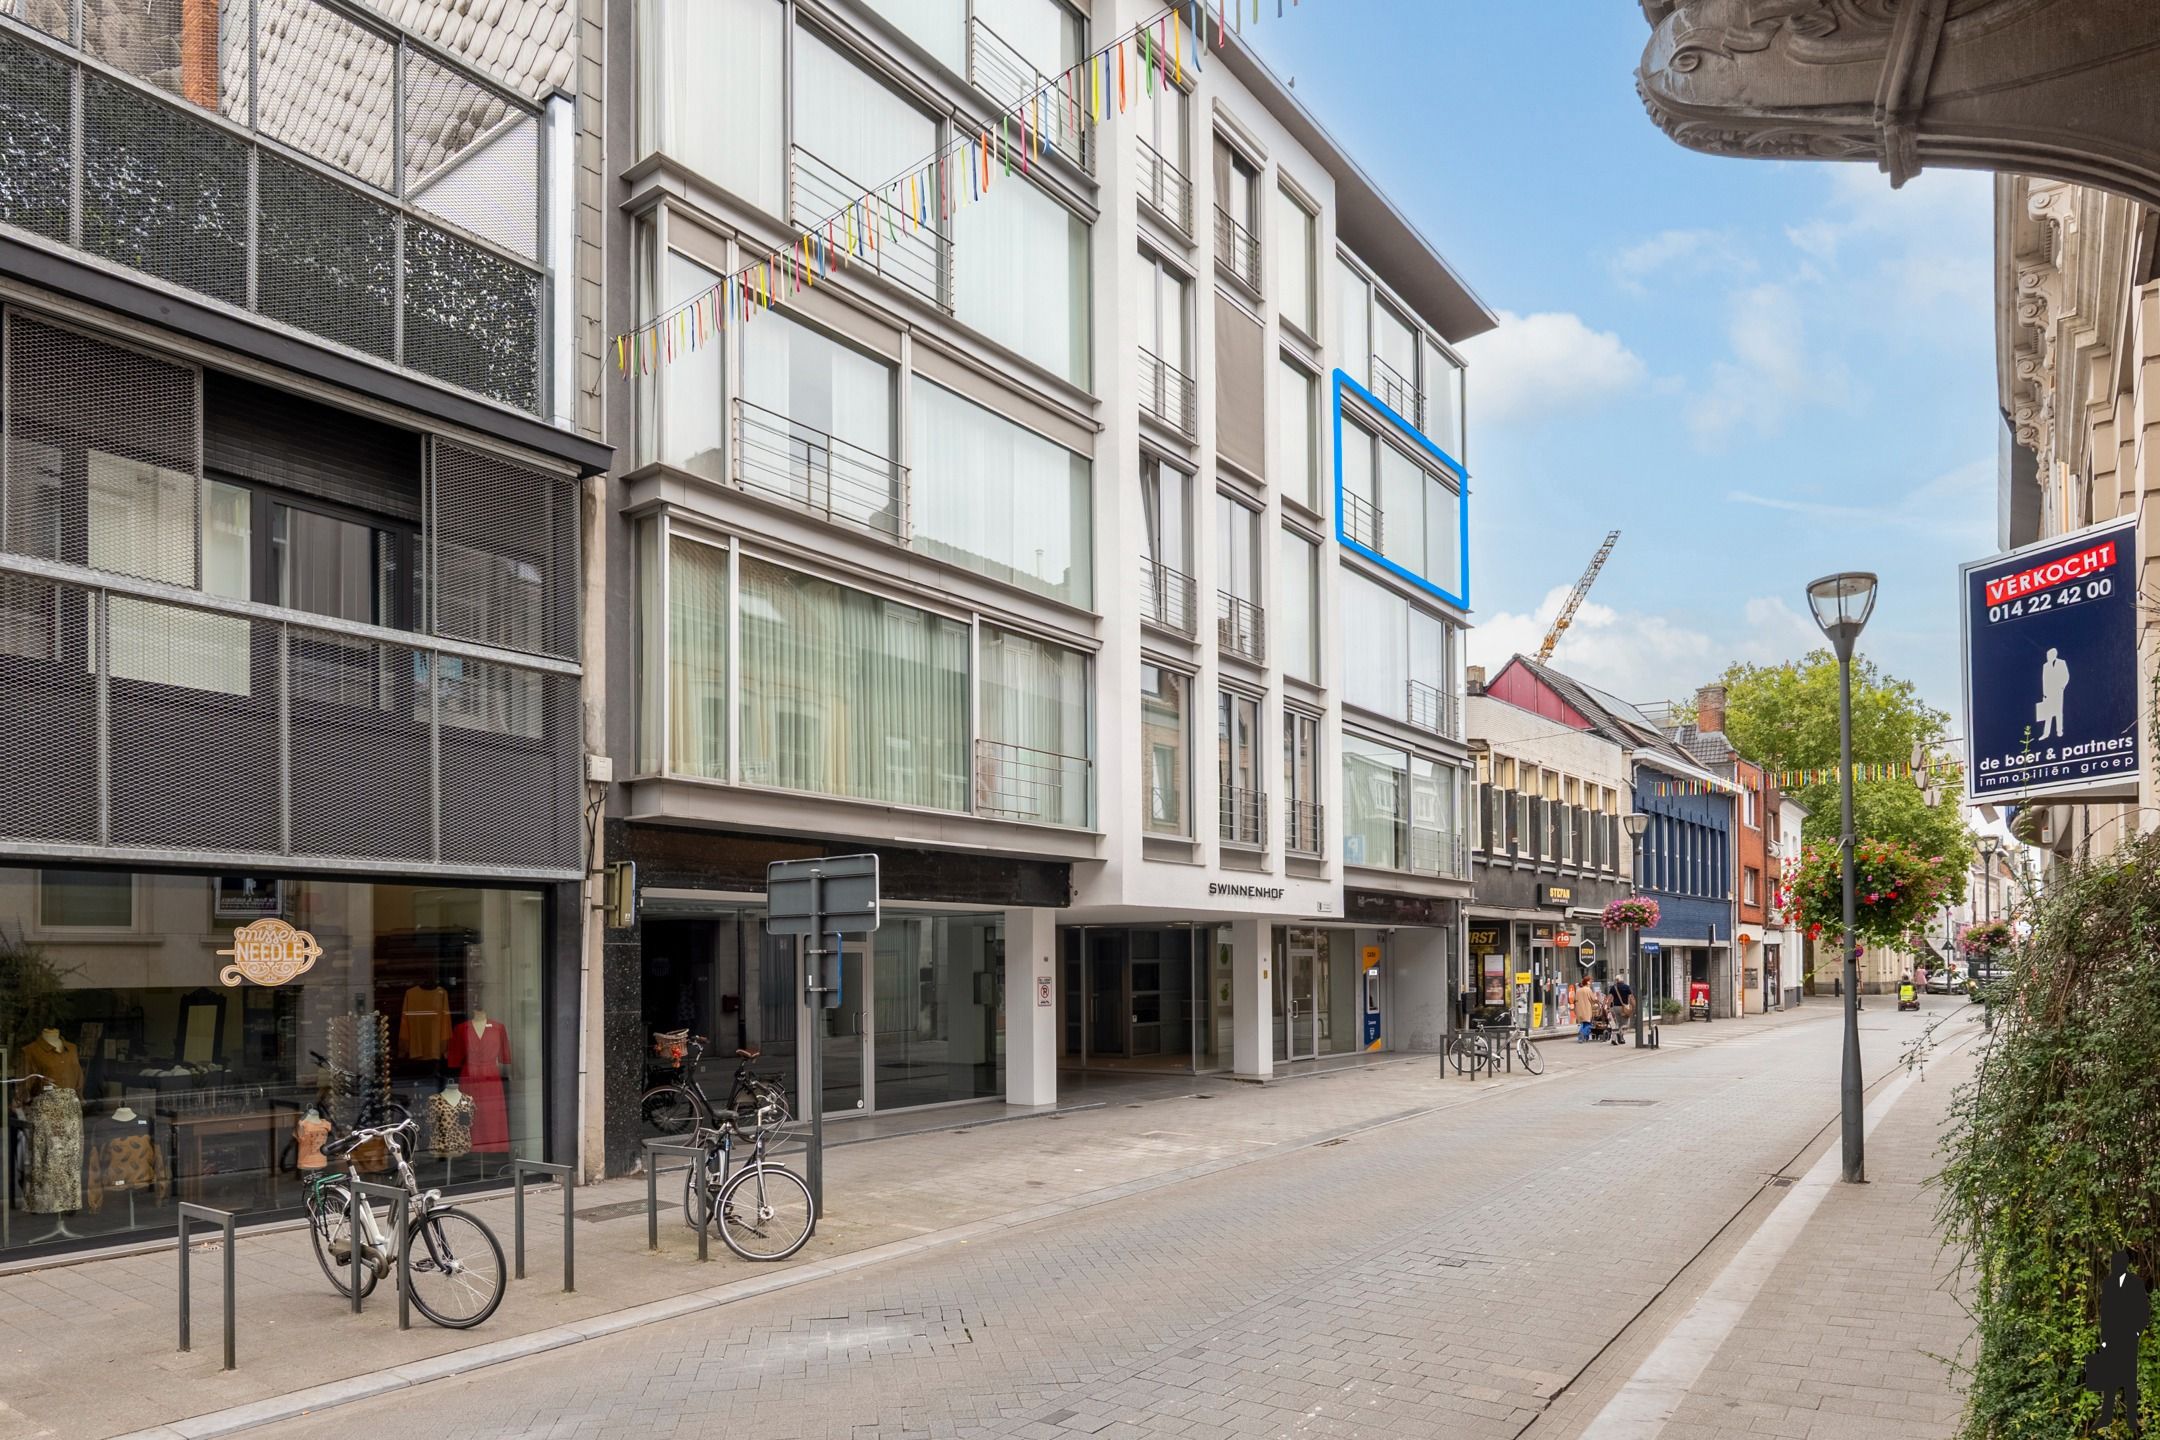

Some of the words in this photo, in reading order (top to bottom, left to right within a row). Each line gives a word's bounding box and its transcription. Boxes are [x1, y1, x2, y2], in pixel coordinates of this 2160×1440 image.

[1990, 546, 2110, 600] VERKOCHT
[1989, 600, 2023, 623] 014
[2028, 593, 2052, 614] 22
[2057, 586, 2081, 605] 42
[2086, 578, 2112, 599] 00
[1980, 757, 2000, 771] de
[2005, 751, 2041, 767] boer
[2046, 748, 2057, 760] &
[2062, 736, 2134, 760] partners
[1980, 766, 2070, 787] immobiliën
[2081, 756, 2134, 774] groep
[1209, 883, 1285, 899] SWINNENHOF
[1549, 887, 1570, 899] STEFAN
[236, 928, 299, 944] misses
[1557, 933, 1569, 941] ria
[237, 942, 303, 961] NEEDLE
